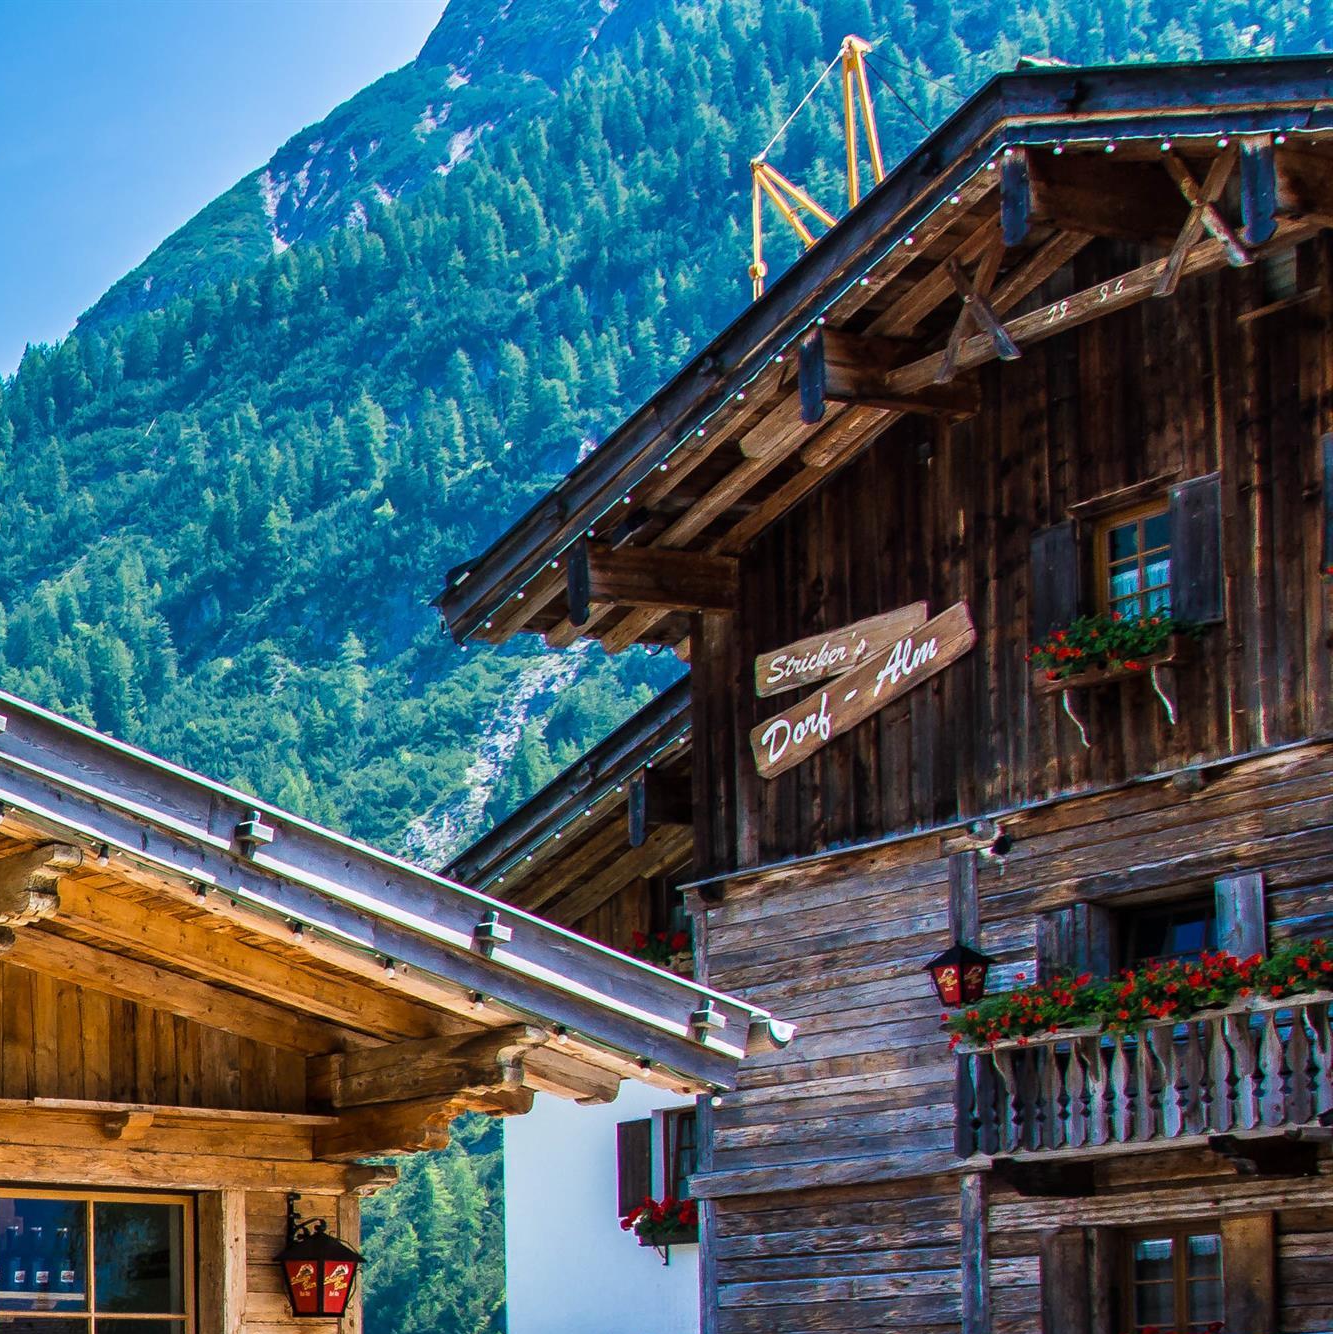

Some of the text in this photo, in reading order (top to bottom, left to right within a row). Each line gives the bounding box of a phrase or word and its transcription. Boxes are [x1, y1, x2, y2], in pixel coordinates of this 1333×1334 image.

[760, 692, 832, 764] Dorf
[873, 637, 939, 698] Alm
[766, 631, 866, 684] Stricker's
